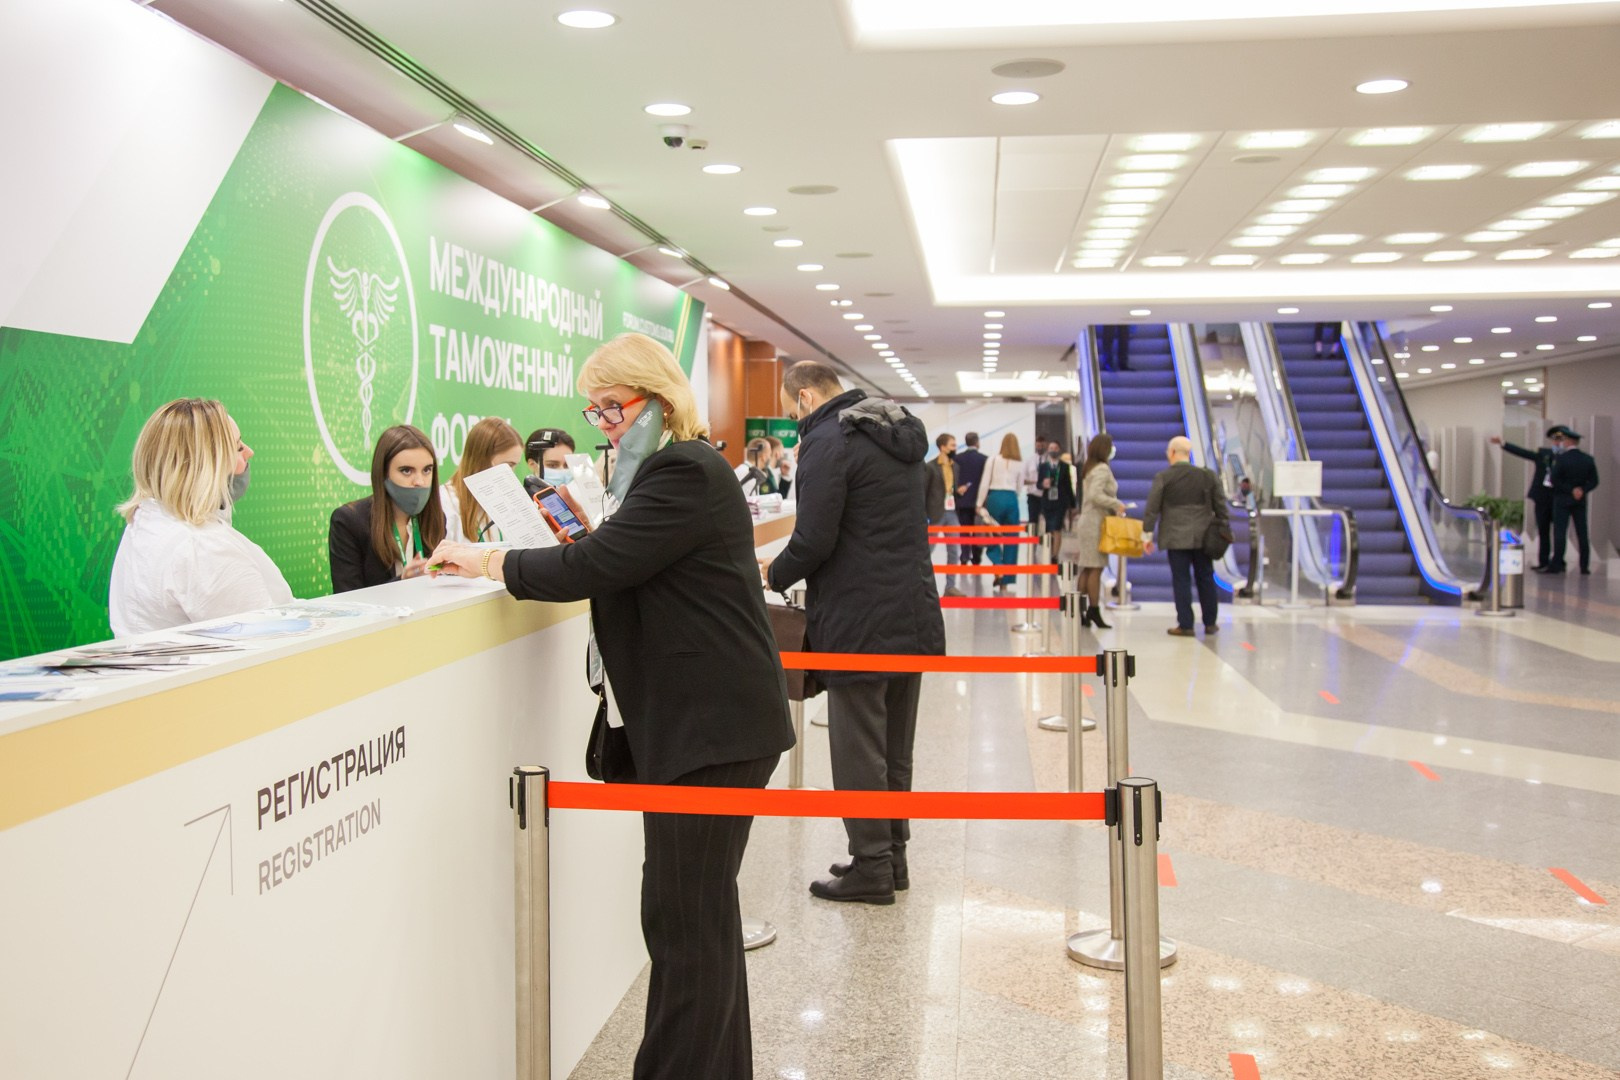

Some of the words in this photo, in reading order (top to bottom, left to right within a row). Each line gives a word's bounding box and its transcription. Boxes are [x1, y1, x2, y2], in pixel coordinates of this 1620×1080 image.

[430, 236, 603, 341] МЕЖДУНАРОДНЫЙ
[429, 324, 574, 398] ТАМОЖЕННЫЙ
[257, 725, 406, 831] РЕГИСТРАЦИЯ
[258, 798, 381, 895] REGISTRATION
